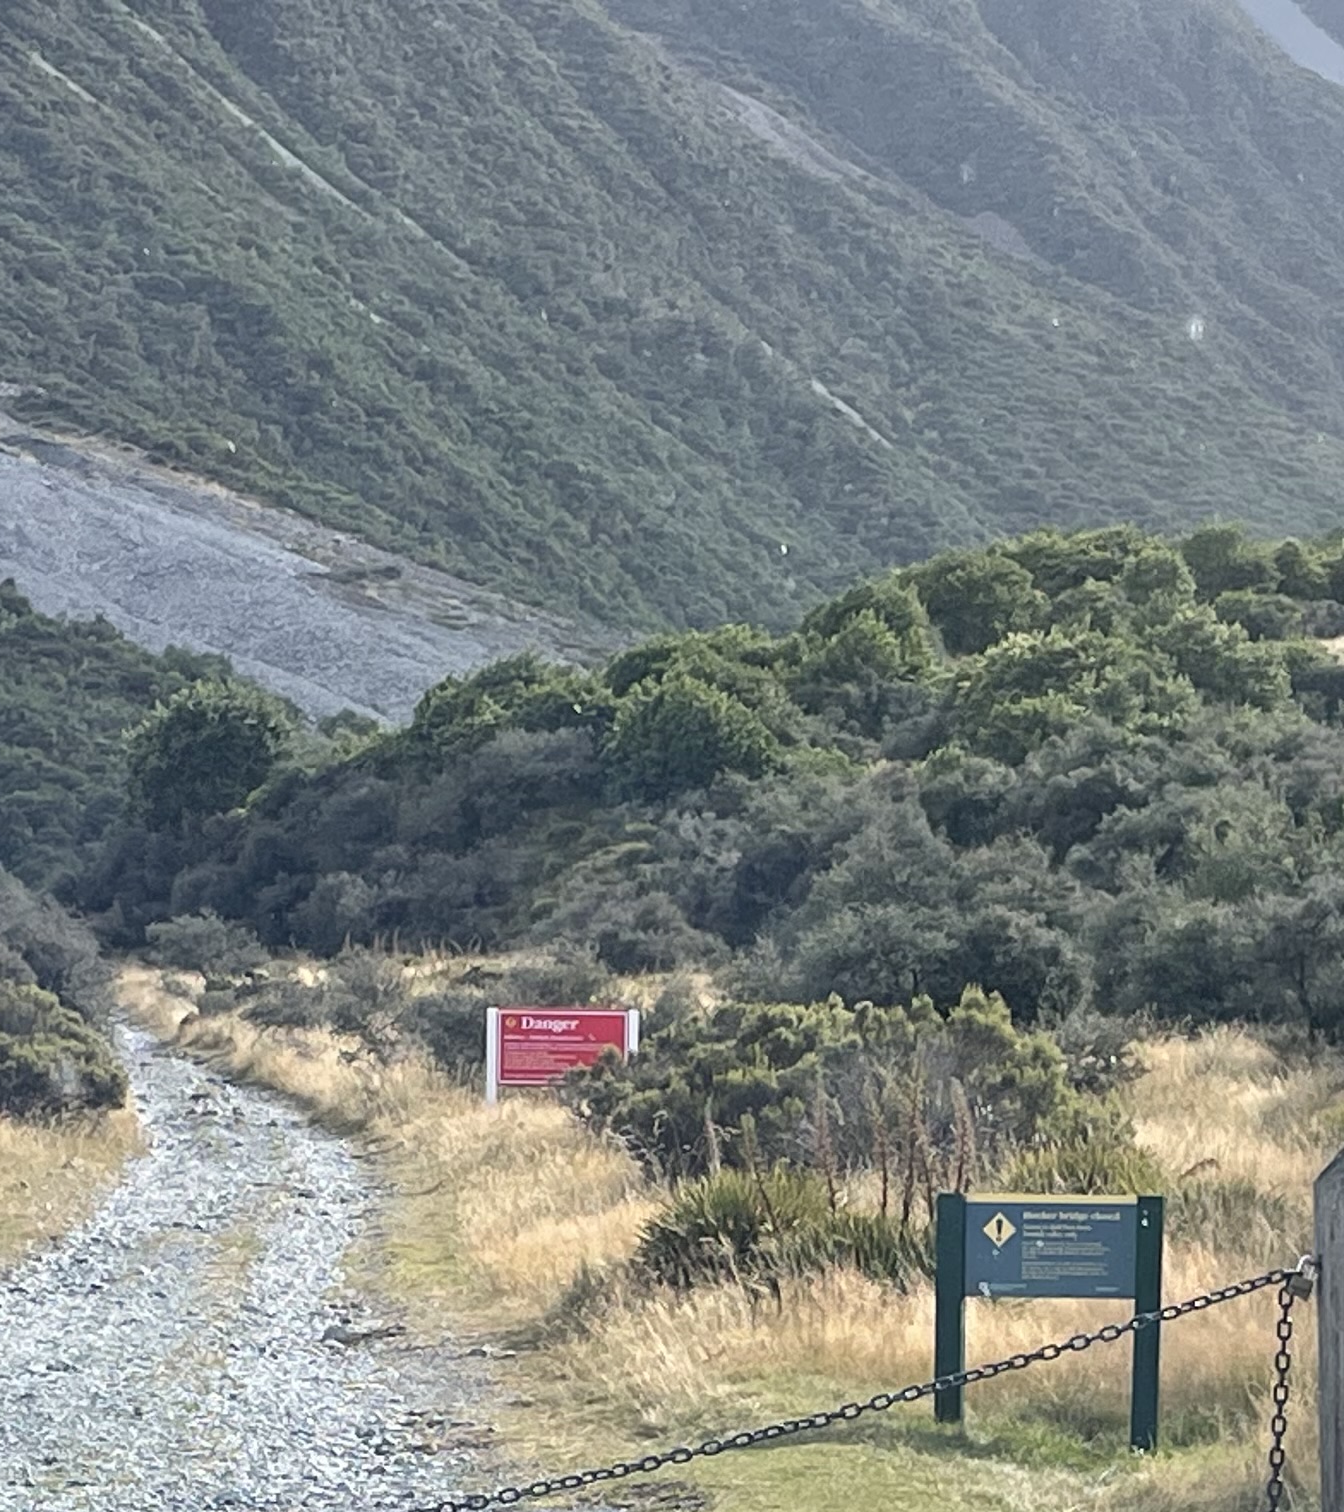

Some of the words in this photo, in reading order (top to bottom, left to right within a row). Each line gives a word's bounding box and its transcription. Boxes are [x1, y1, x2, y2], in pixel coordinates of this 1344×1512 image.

[521, 1016, 580, 1033] Danger
[1059, 1211, 1088, 1222] bridge
[1090, 1212, 1120, 1221] closed
